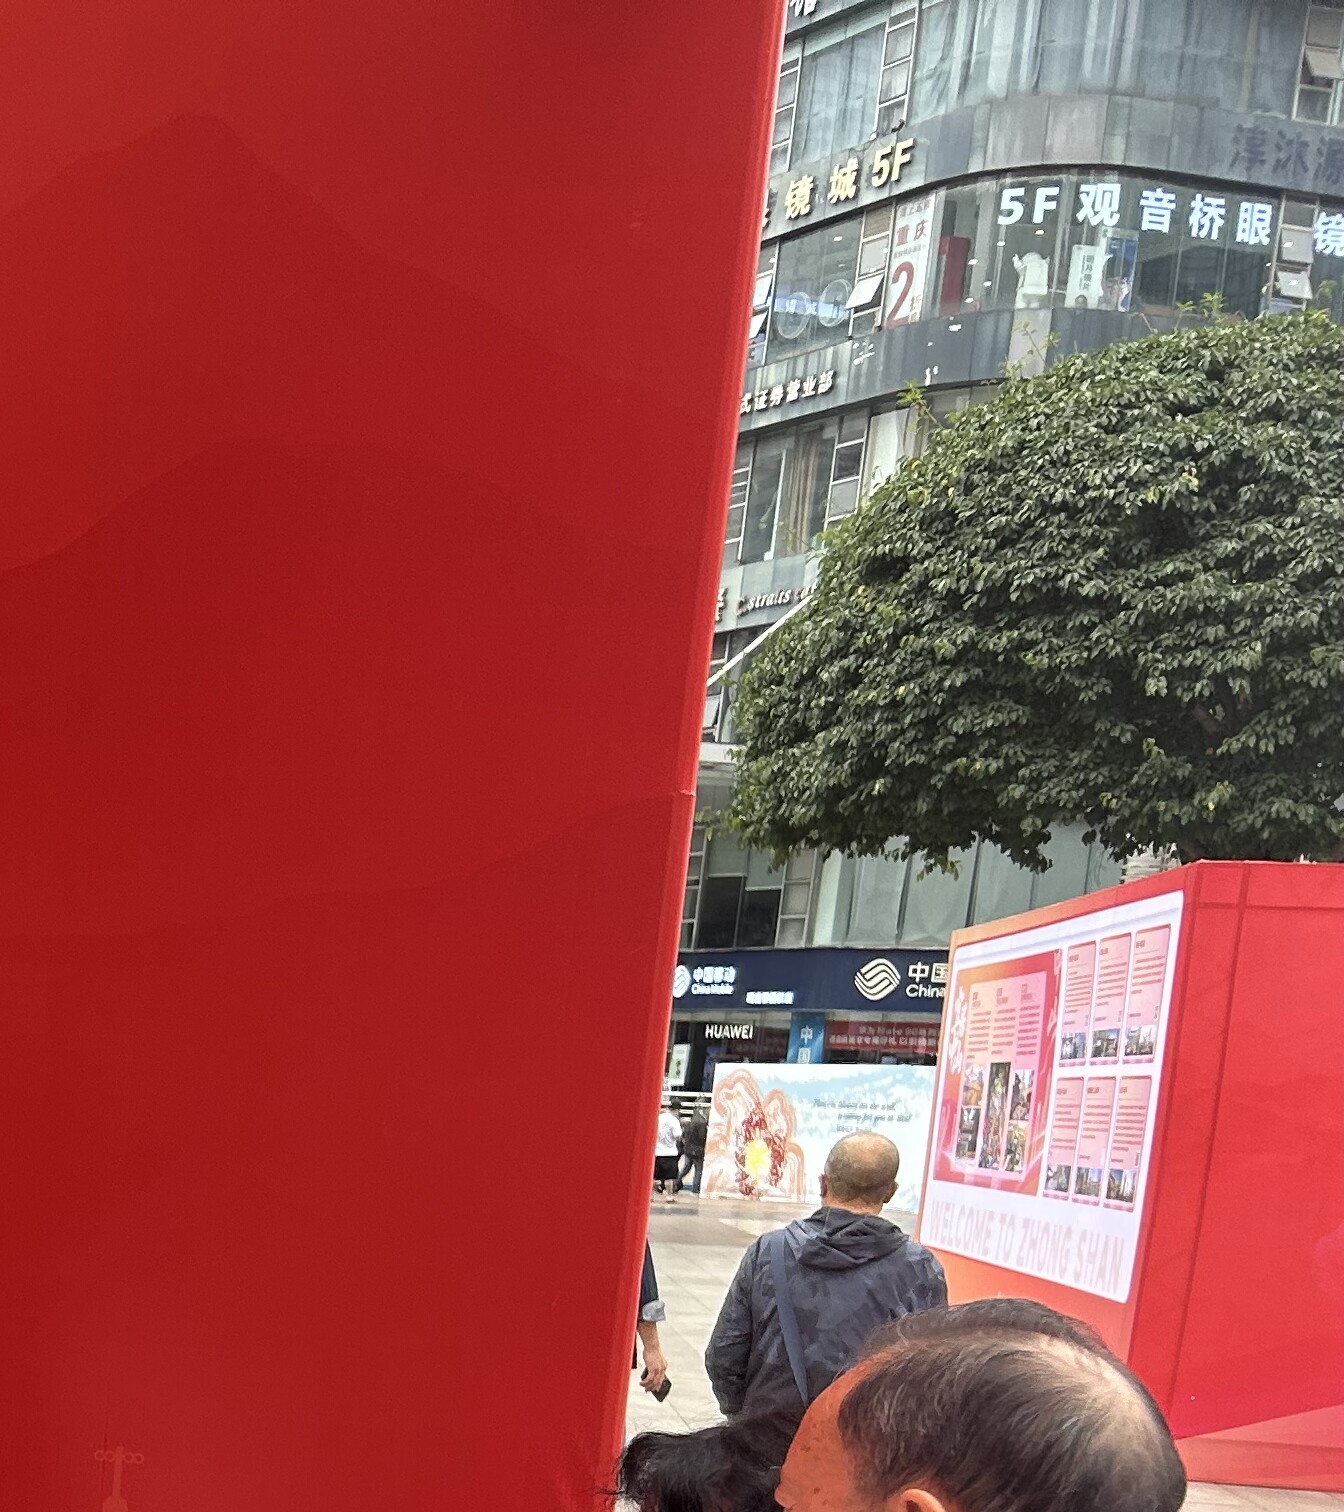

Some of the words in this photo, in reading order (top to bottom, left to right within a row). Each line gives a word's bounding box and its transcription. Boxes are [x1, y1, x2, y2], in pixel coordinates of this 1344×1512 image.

[705, 1024, 753, 1040] HUAWEI
[929, 1201, 996, 1259] WELCOME
[999, 1213, 1014, 1262] TO
[1017, 1217, 1072, 1280] ZHONG
[1078, 1230, 1124, 1294] SHAN
